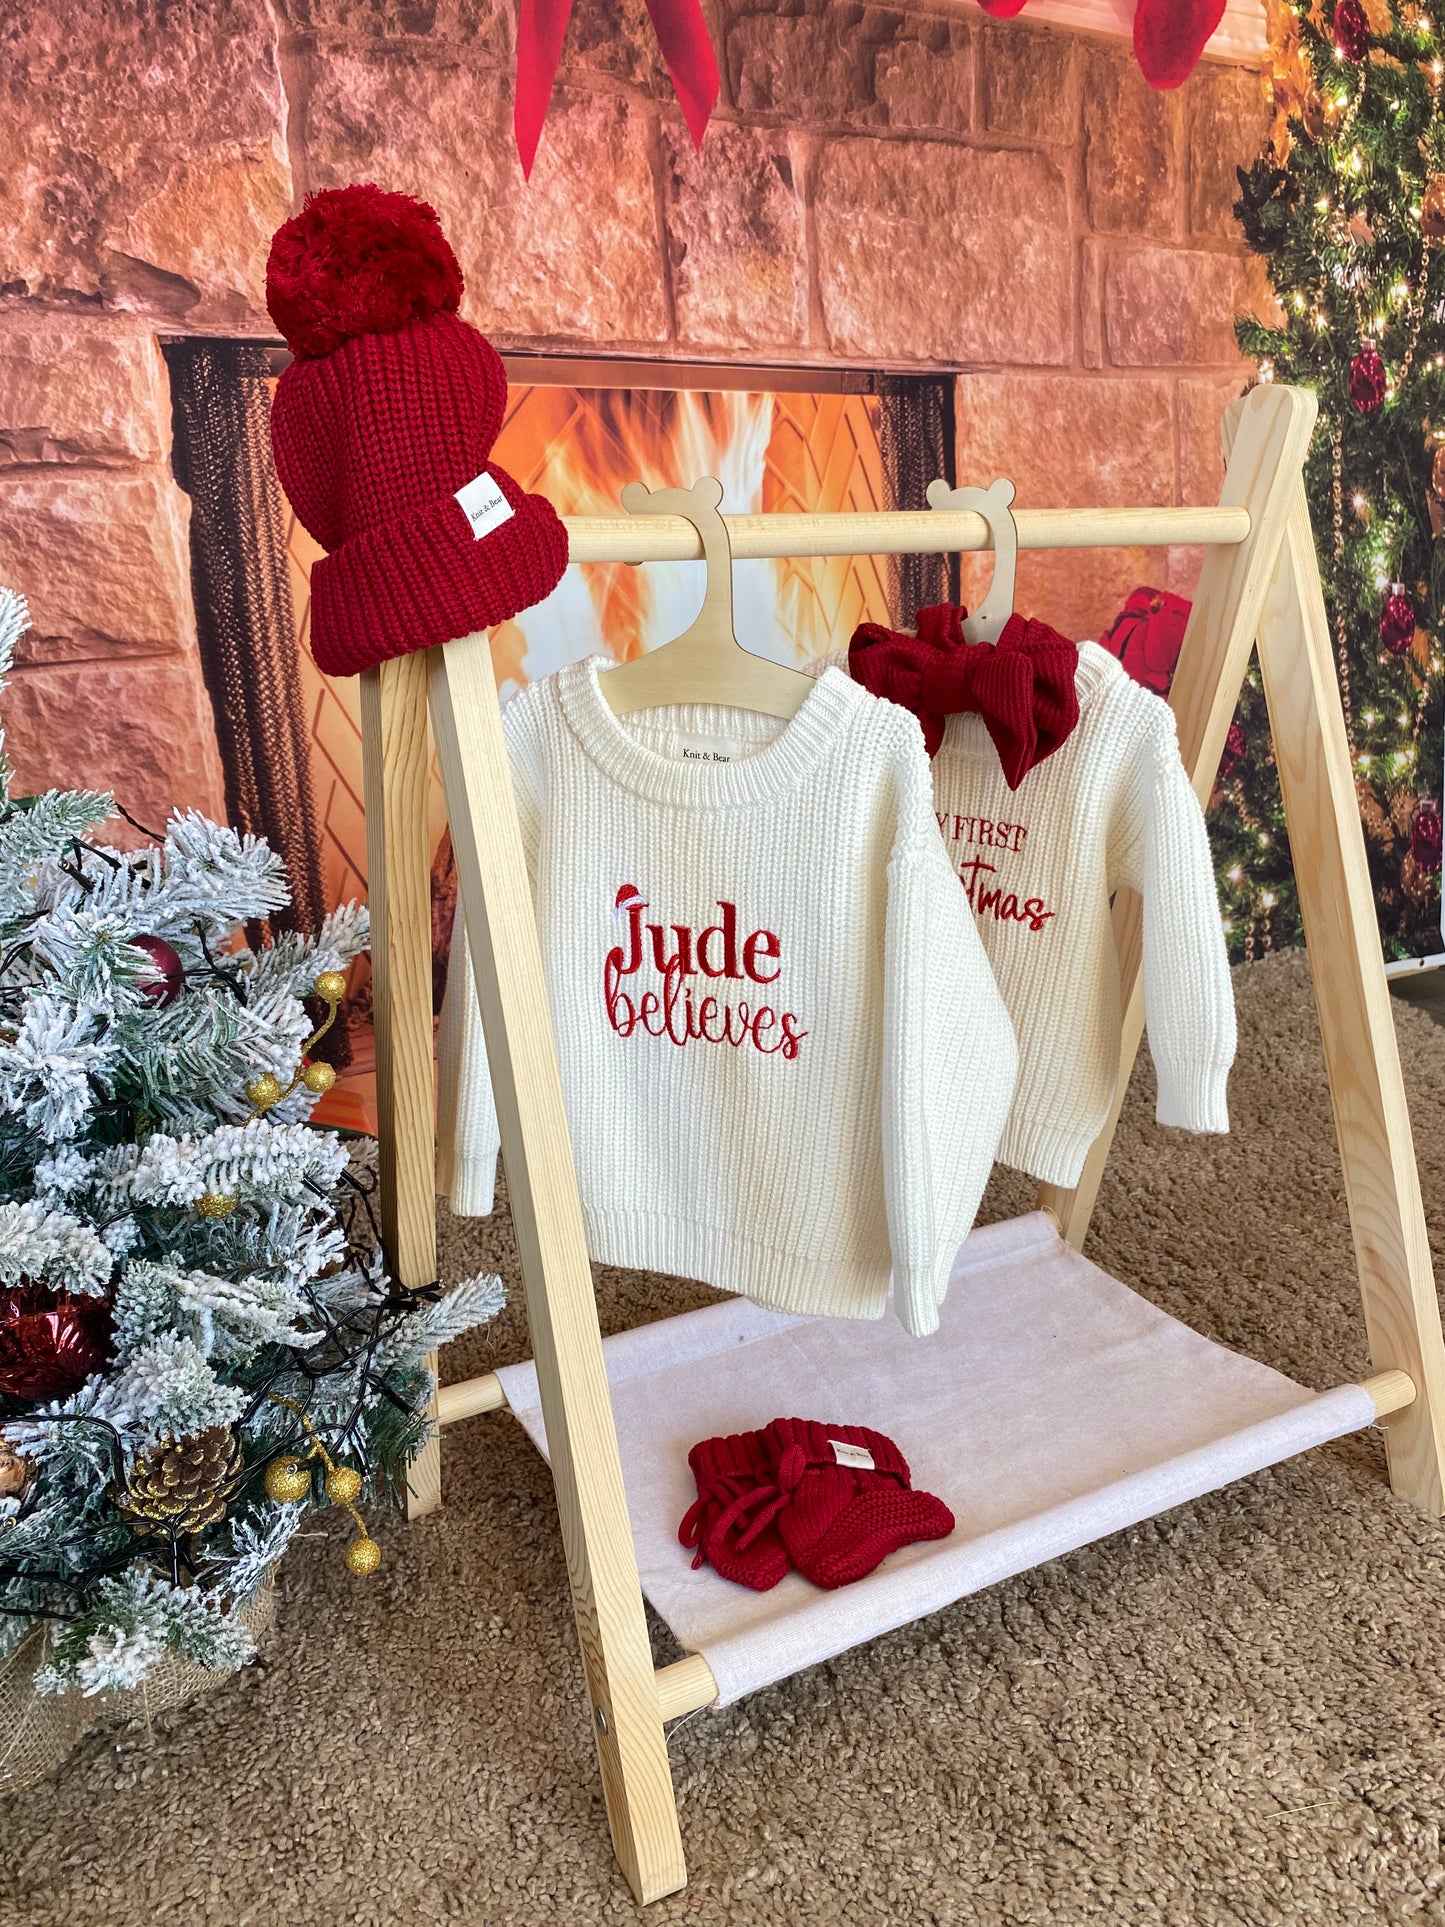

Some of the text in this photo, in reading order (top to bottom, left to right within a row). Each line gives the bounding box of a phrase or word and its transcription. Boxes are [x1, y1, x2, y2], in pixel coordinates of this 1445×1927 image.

[471, 496, 502, 521] Knit & Bear
[683, 748, 730, 762] Knit & Bear
[935, 812, 1028, 852] Y FIRST
[959, 854, 1056, 931] tmas
[616, 899, 782, 985] Jude
[604, 947, 809, 1060] believes
